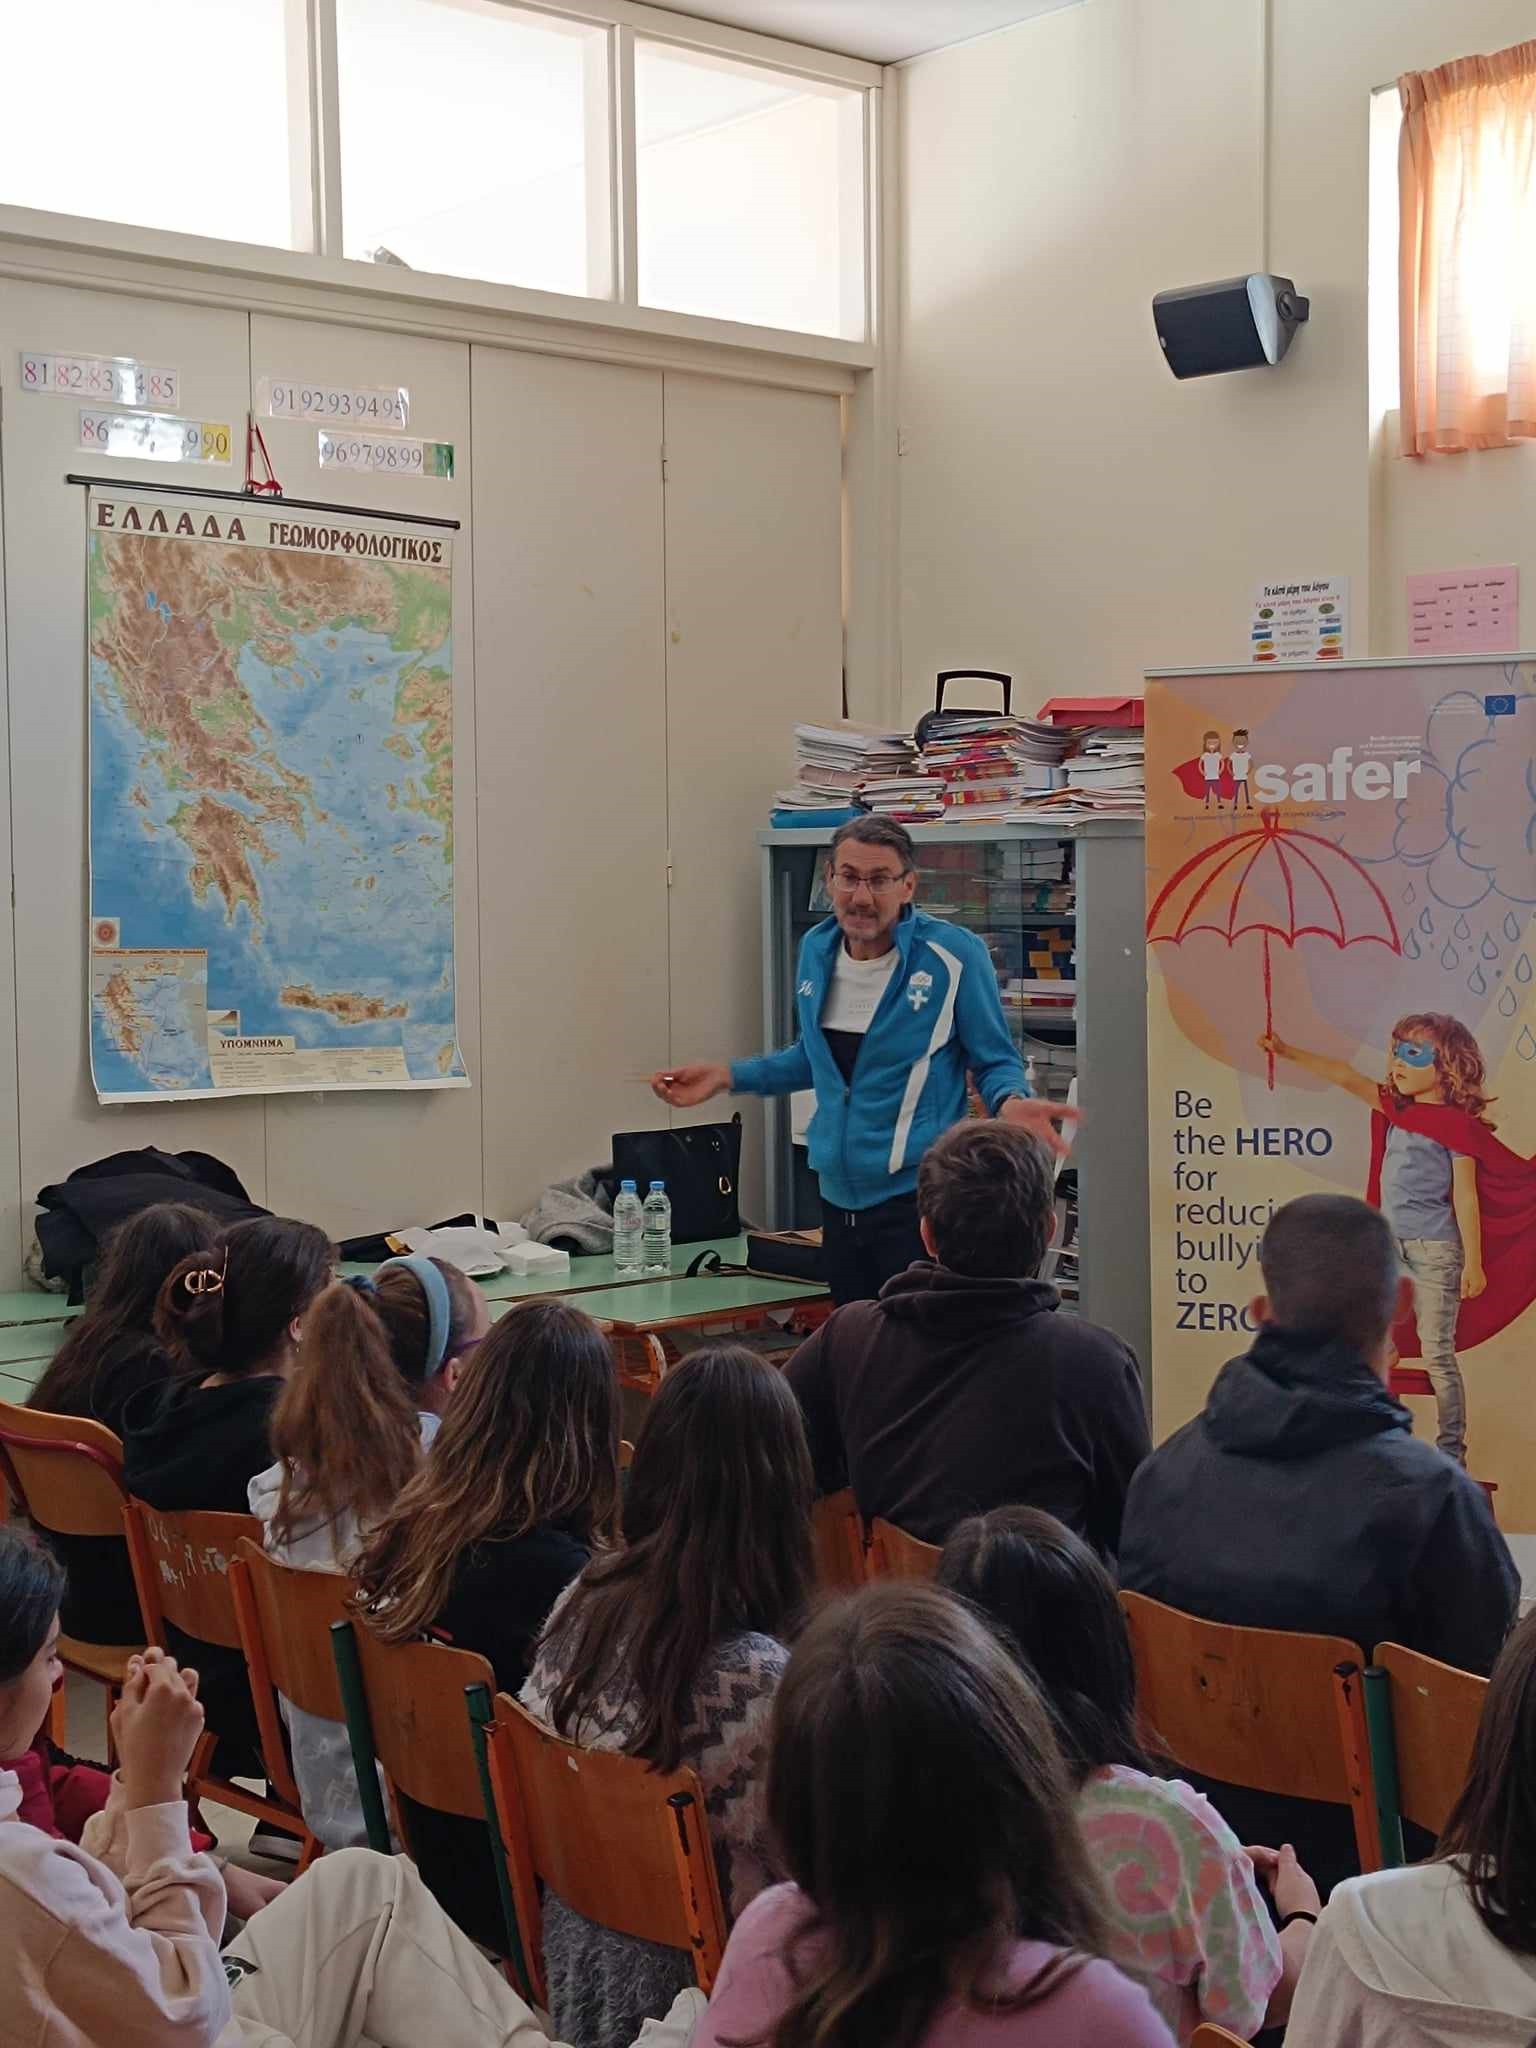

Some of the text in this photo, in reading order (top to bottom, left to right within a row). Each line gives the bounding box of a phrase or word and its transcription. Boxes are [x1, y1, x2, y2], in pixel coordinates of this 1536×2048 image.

[25, 360, 47, 385] 81
[57, 366, 82, 388] 82
[89, 367, 113, 391] 83
[151, 375, 174, 398] 85
[273, 387, 294, 410] 91
[301, 390, 324, 412] 92
[329, 393, 350, 415] 93
[356, 395, 379, 417] 94
[83, 416, 109, 442] 86
[203, 431, 228, 454] 90
[350, 443, 372, 464] 97
[375, 446, 397, 468] 98
[400, 448, 423, 469] 99
[97, 503, 442, 563] ΕΛΛΑΔΑ ΓΕΩΜΟΡΦΟΛΟΓΙΚΟΣ
[1254, 747, 1421, 803] safer
[220, 1039, 284, 1049] ΥΠΟΜΝΗΜΑ
[1174, 1090, 1212, 1119] Be
[1174, 1126, 1333, 1156] the HERO
[1174, 1162, 1218, 1191] for
[1175, 1196, 1274, 1226] reduci
[1176, 1231, 1262, 1271] bullyi
[1175, 1268, 1207, 1294] to
